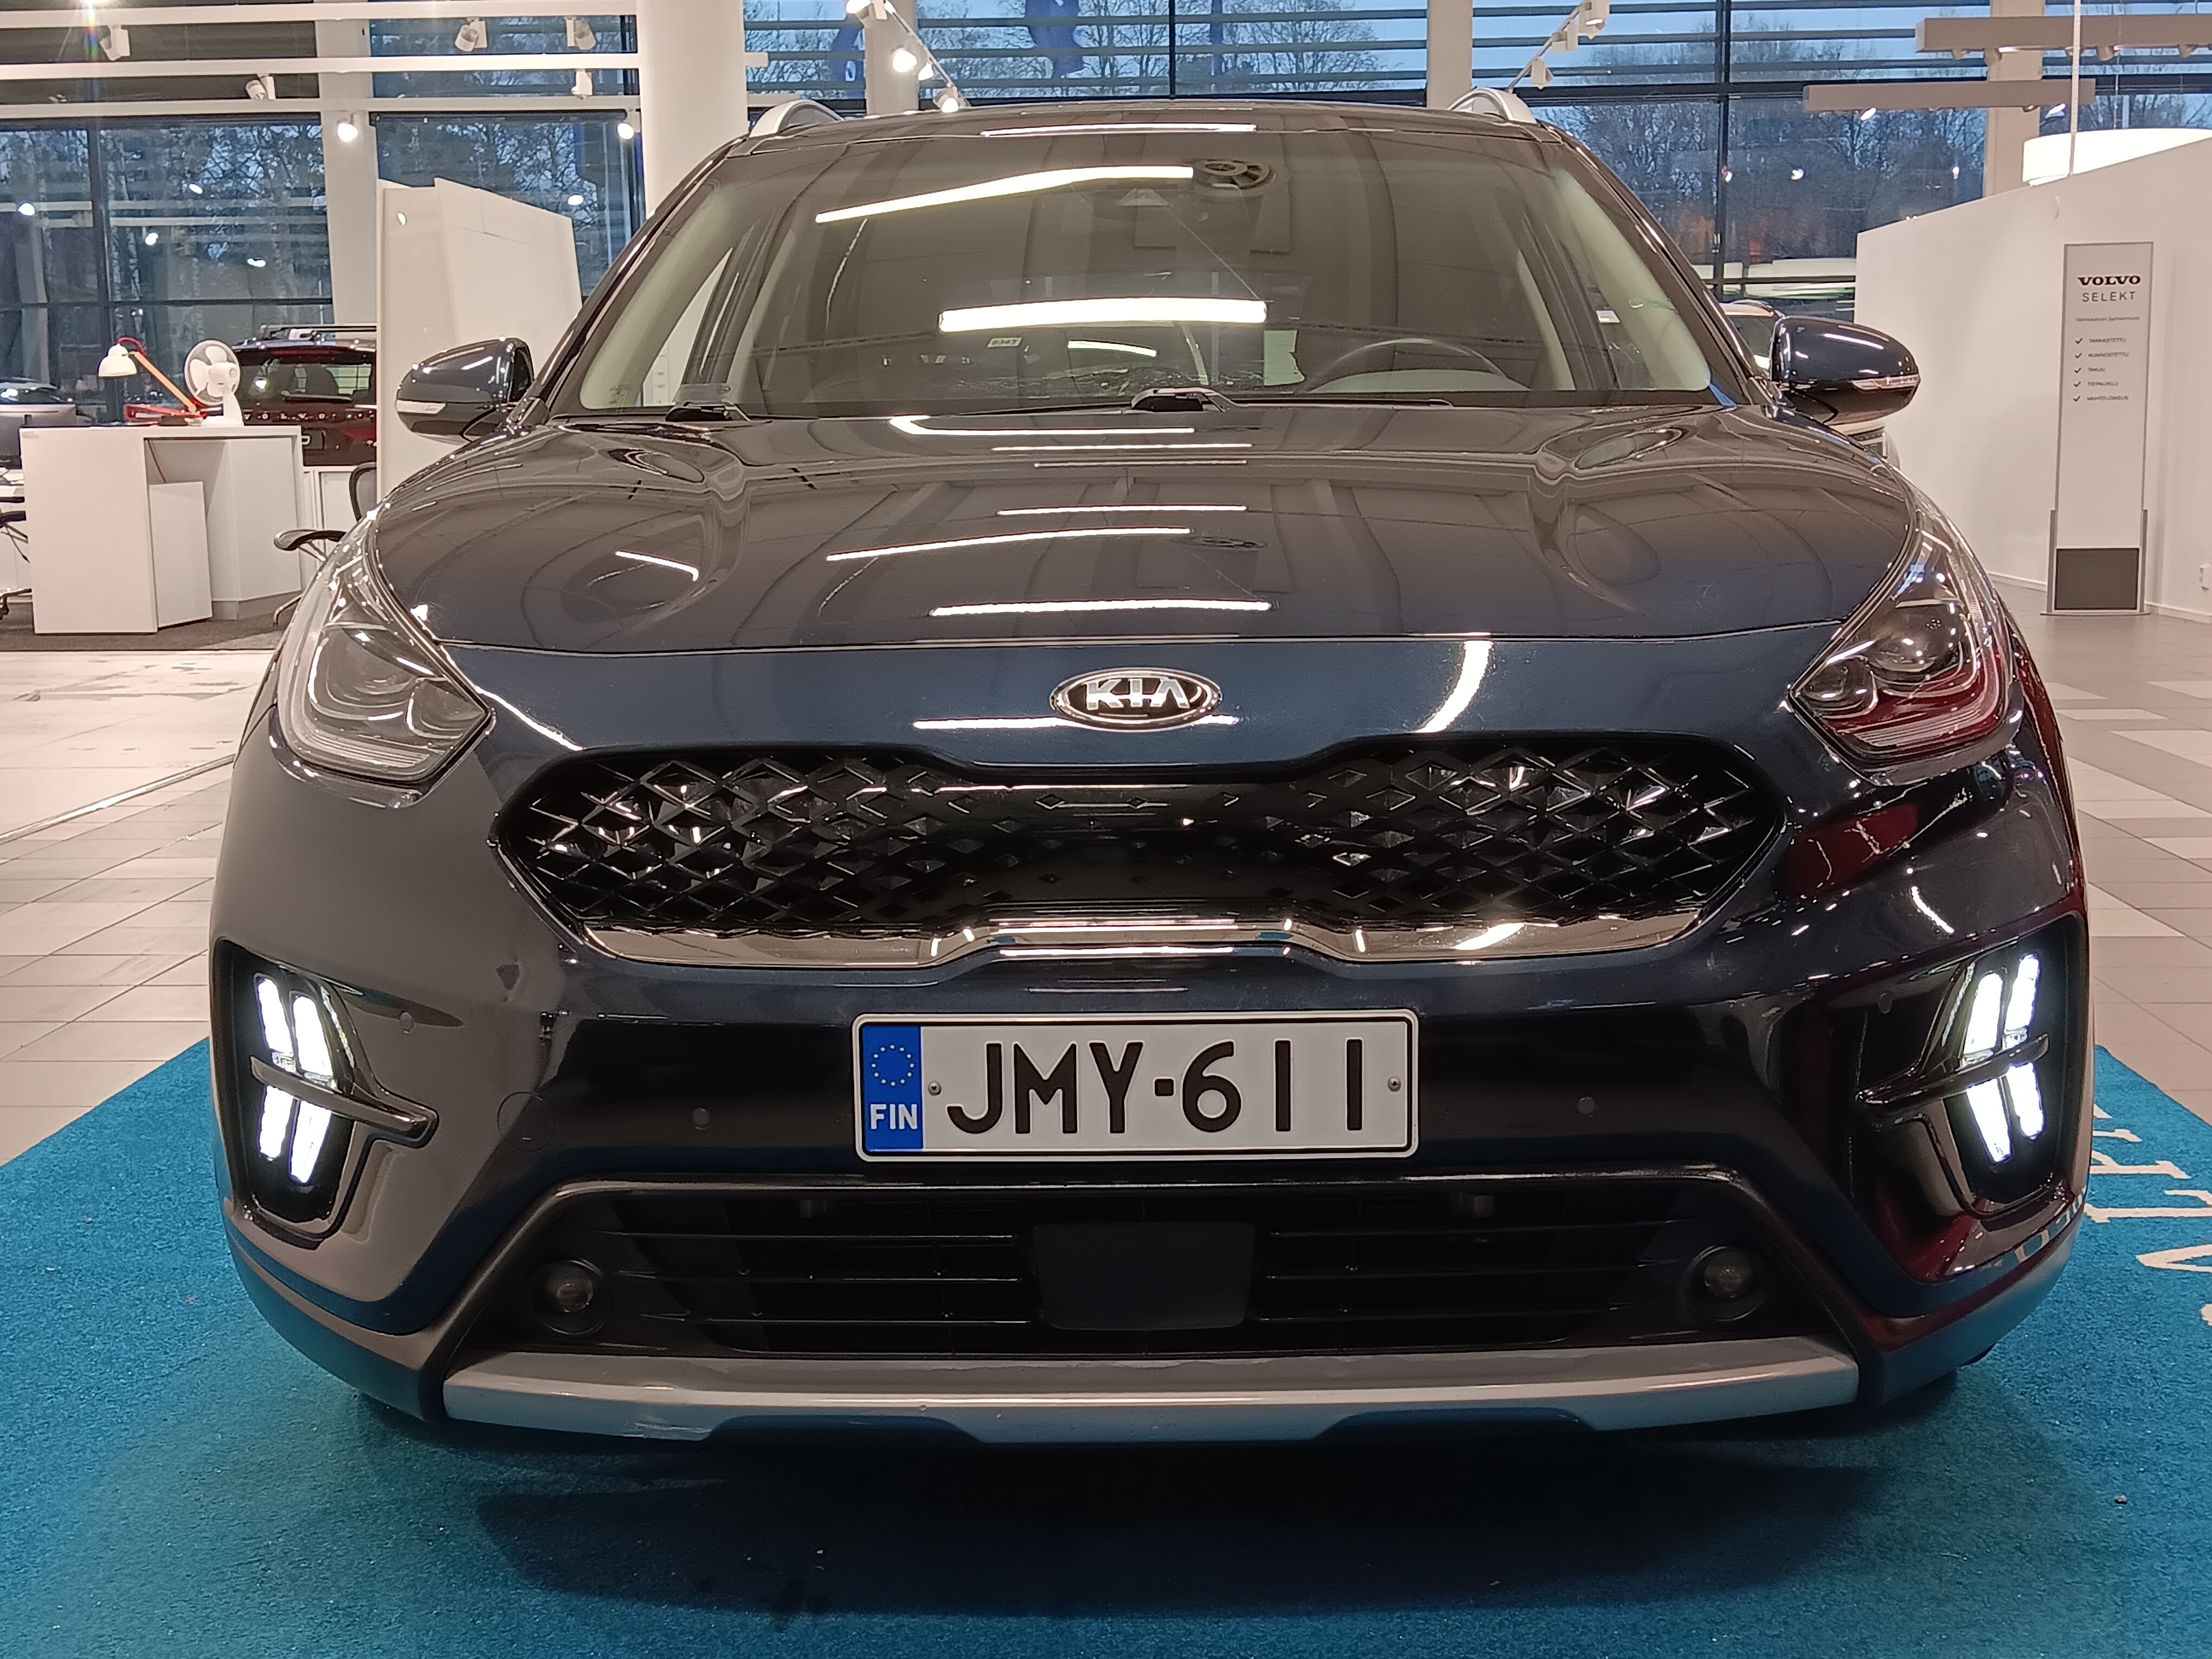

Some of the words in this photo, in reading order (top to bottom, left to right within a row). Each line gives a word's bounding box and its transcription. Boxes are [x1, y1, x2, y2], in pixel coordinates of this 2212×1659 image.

[2078, 275, 2140, 285] VOLVO
[2082, 291, 2136, 302] SELEKT
[1086, 678, 1190, 710] KIA
[947, 1039, 1362, 1134] JMY-611
[871, 1103, 917, 1129] FIN
